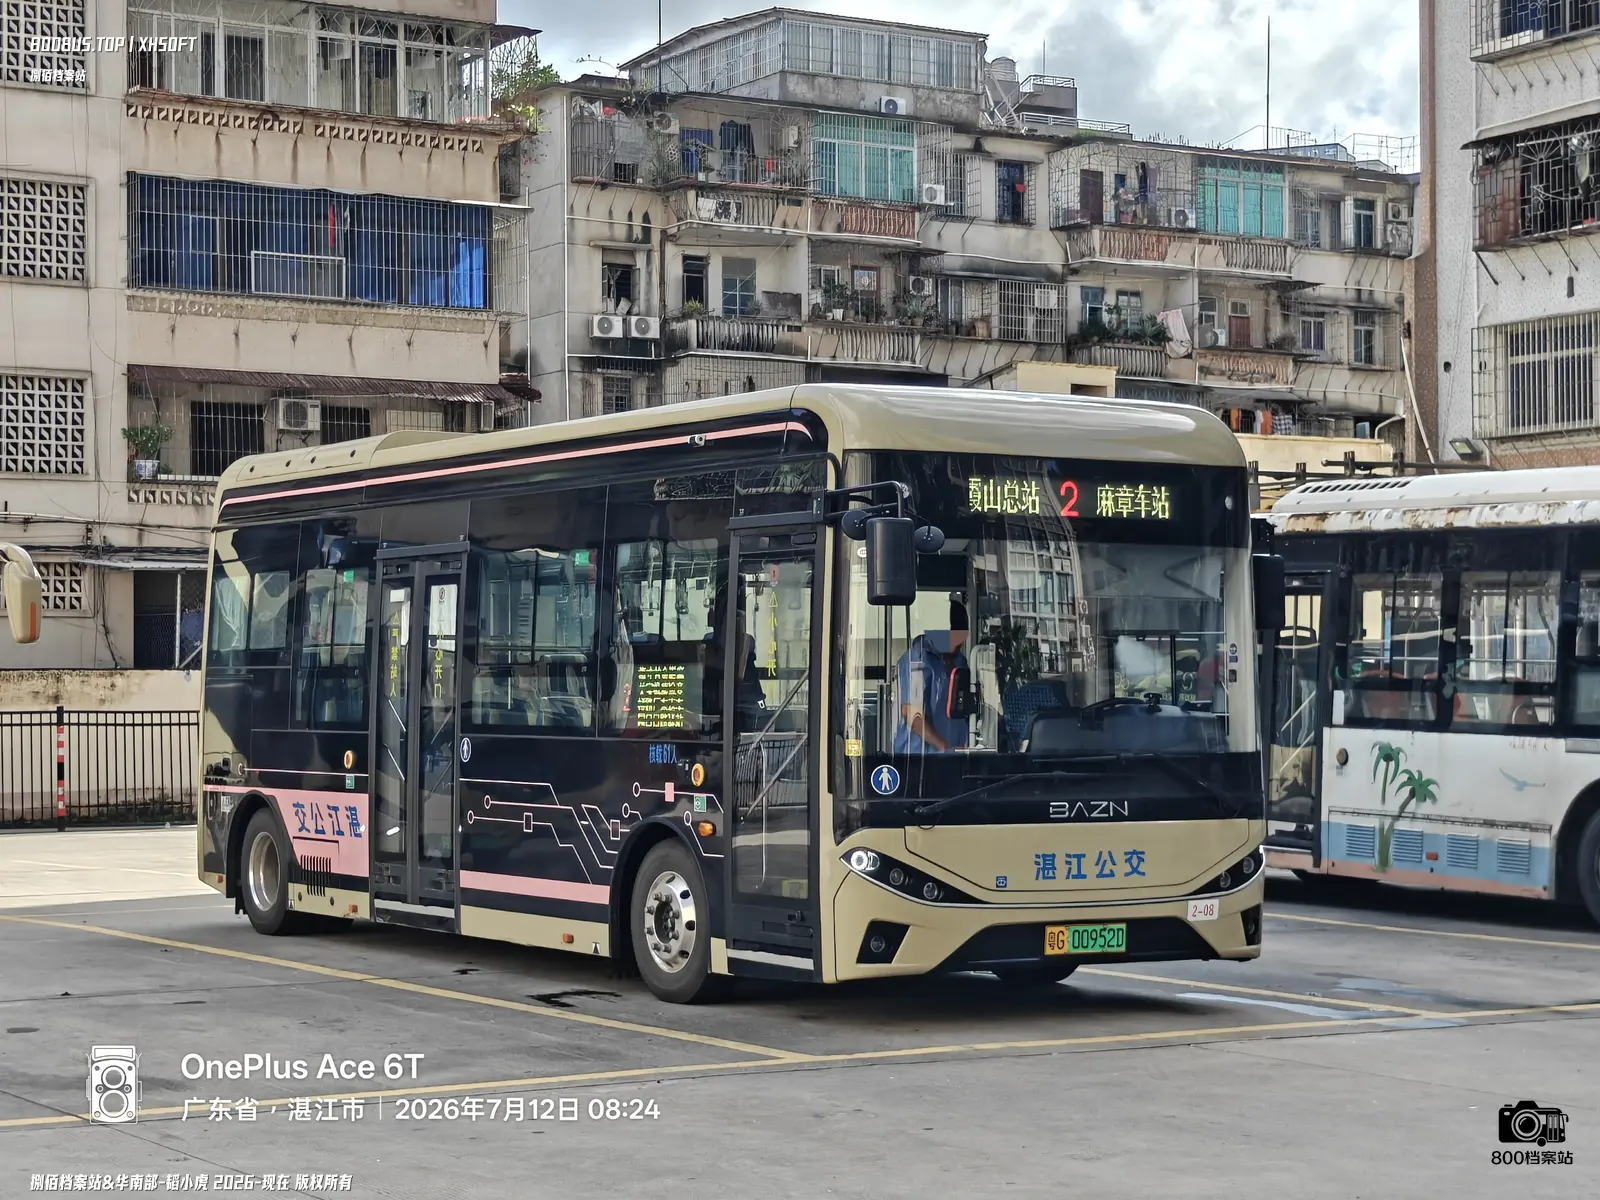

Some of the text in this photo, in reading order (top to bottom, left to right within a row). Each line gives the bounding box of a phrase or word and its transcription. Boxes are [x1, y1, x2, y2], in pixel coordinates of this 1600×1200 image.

[1060, 481, 1079, 517] 2
[1096, 484, 1170, 519] 麻章车站
[1050, 801, 1128, 818] BAZN
[1034, 849, 1146, 881] 湛江公交
[1191, 903, 1214, 917] 2-08
